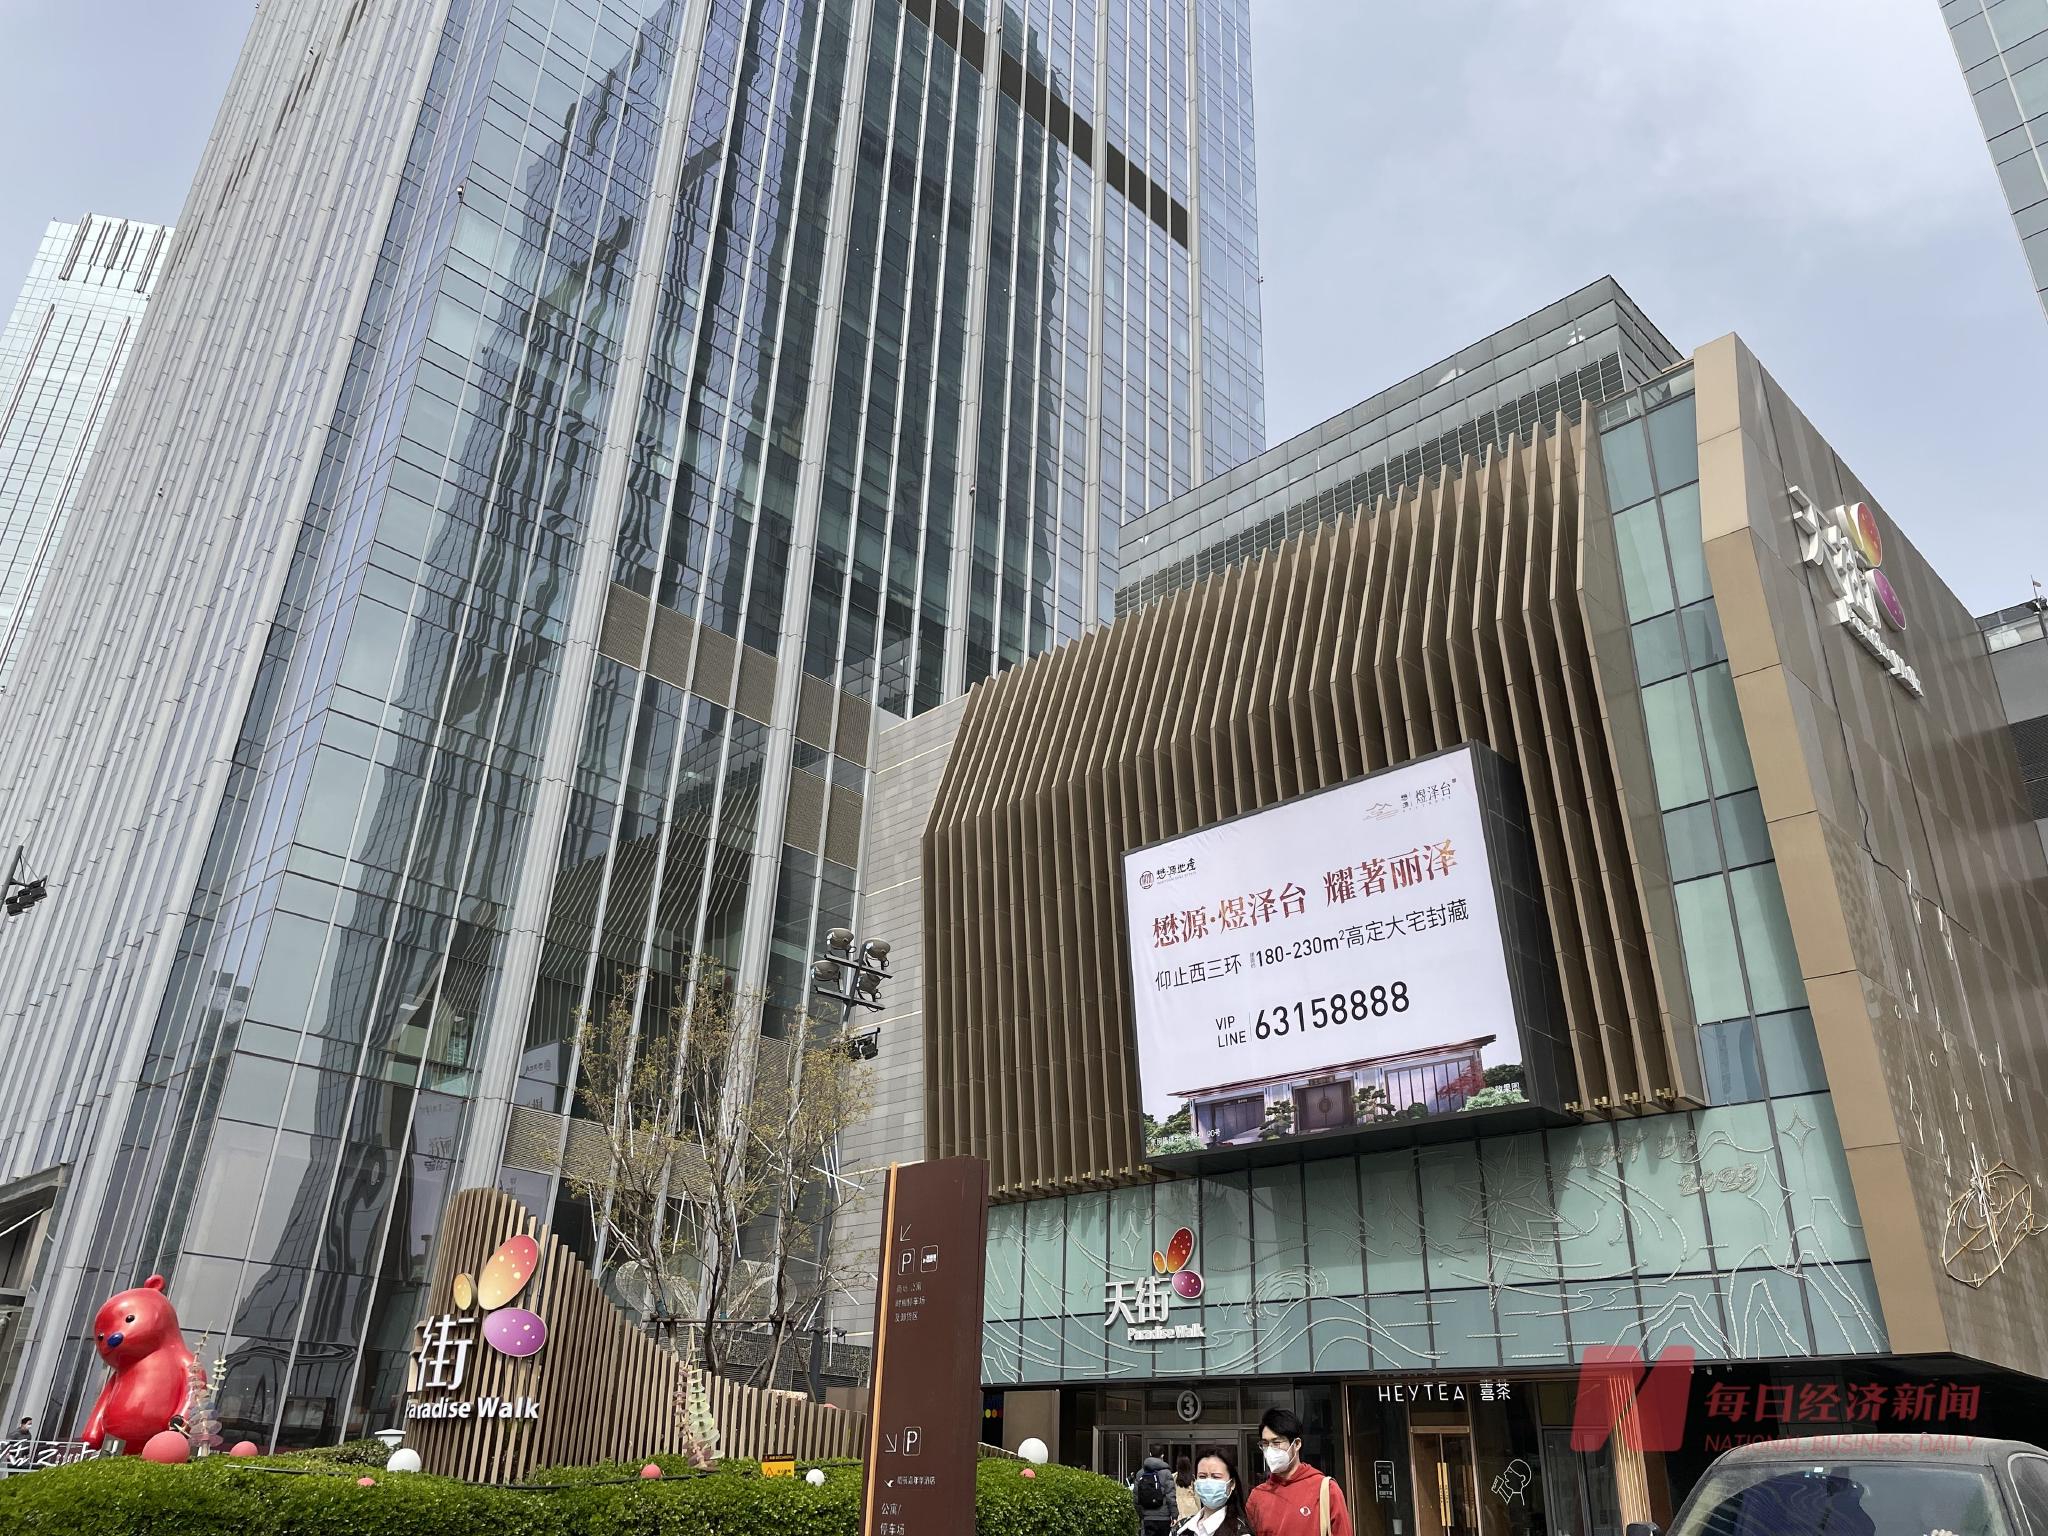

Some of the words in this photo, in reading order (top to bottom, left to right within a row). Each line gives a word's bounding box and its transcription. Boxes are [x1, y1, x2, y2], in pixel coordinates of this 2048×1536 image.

[1152, 883, 1306, 949] 懋源·煜泽台
[1323, 839, 1458, 907] 耀著丽泽
[1155, 953, 1242, 991] 仰止西三环
[1255, 981, 1410, 1040] 63158888
[1215, 1015, 1236, 1031] VIP
[1217, 1031, 1247, 1048] LINE
[1103, 1275, 1171, 1326] 天街
[1127, 1325, 1176, 1341] Paradise
[1175, 1323, 1206, 1339] Walk
[416, 1314, 475, 1392] 街
[1378, 1383, 1465, 1402] HEYTEA
[1479, 1382, 1511, 1401] 喜茶
[477, 1396, 540, 1419] Walk
[880, 1522, 905, 1536] 停车场
